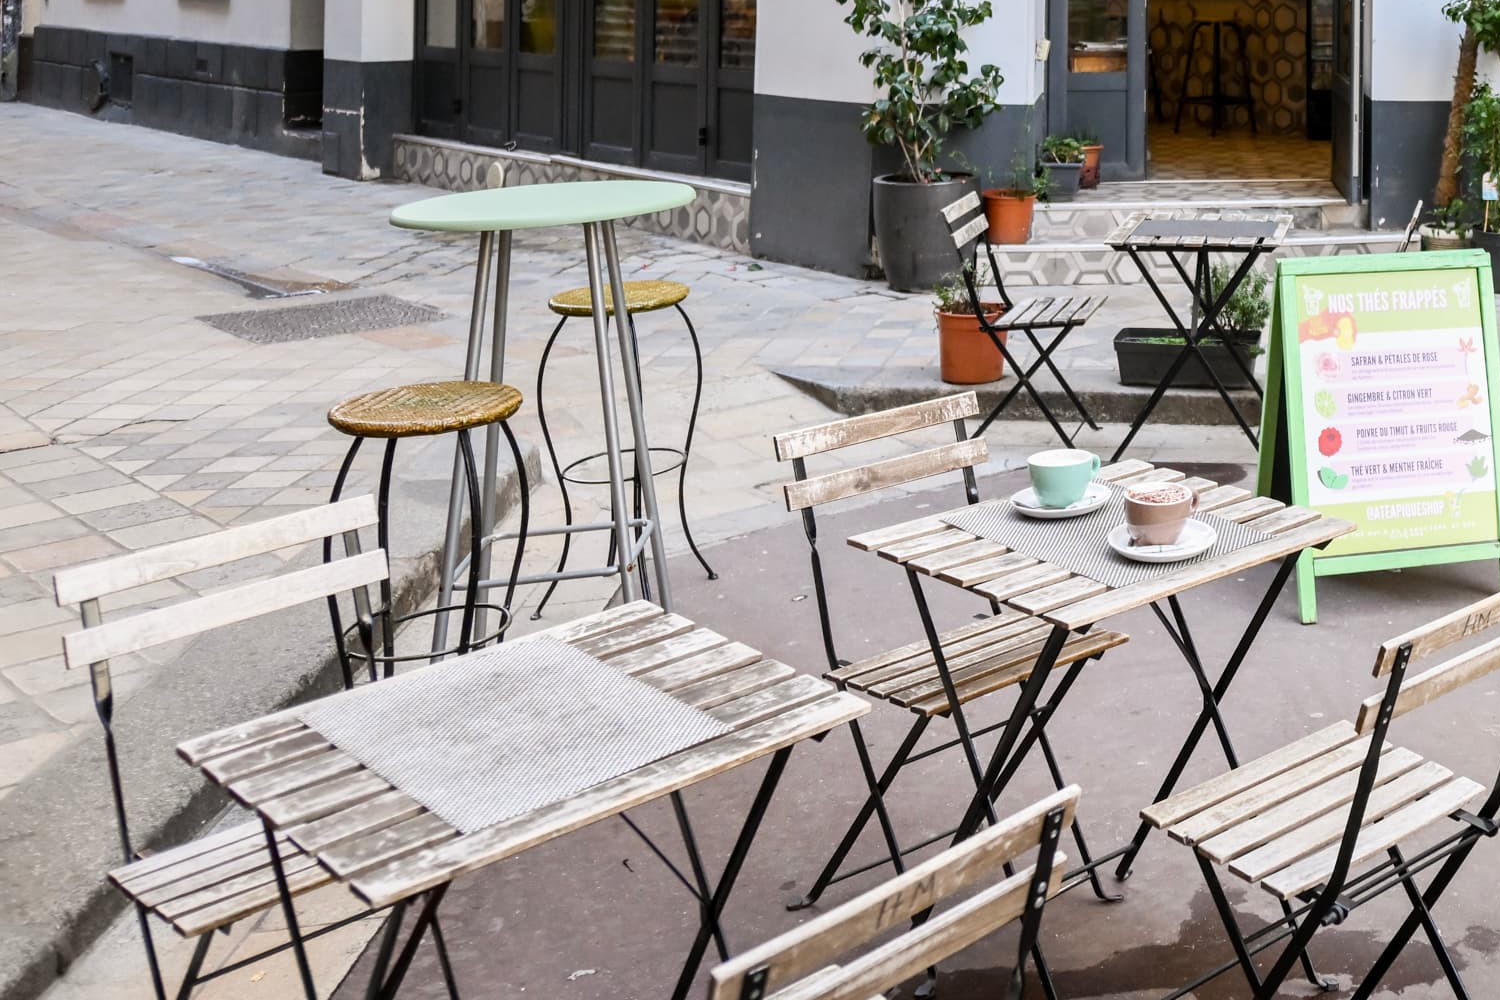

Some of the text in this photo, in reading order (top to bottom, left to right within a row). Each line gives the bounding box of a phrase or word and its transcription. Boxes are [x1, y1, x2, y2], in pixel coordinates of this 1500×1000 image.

[1328, 284, 1448, 314] NOS THÉS FRAPPÉS
[1351, 356, 1376, 367] SAFRAN
[1378, 354, 1383, 365] &
[1412, 351, 1421, 362] DE
[1422, 351, 1438, 362] ROSE
[1347, 387, 1432, 404] GINGEMBRE & CITRON VERT
[1356, 427, 1378, 438] POIVRE
[1380, 427, 1388, 437] DU
[1390, 425, 1408, 436] TIMUT
[1410, 424, 1415, 435] &
[1416, 423, 1437, 434] FRUITS
[1365, 464, 1381, 475] VERT
[1382, 463, 1387, 474] &
[1389, 460, 1415, 473] MENTHE
